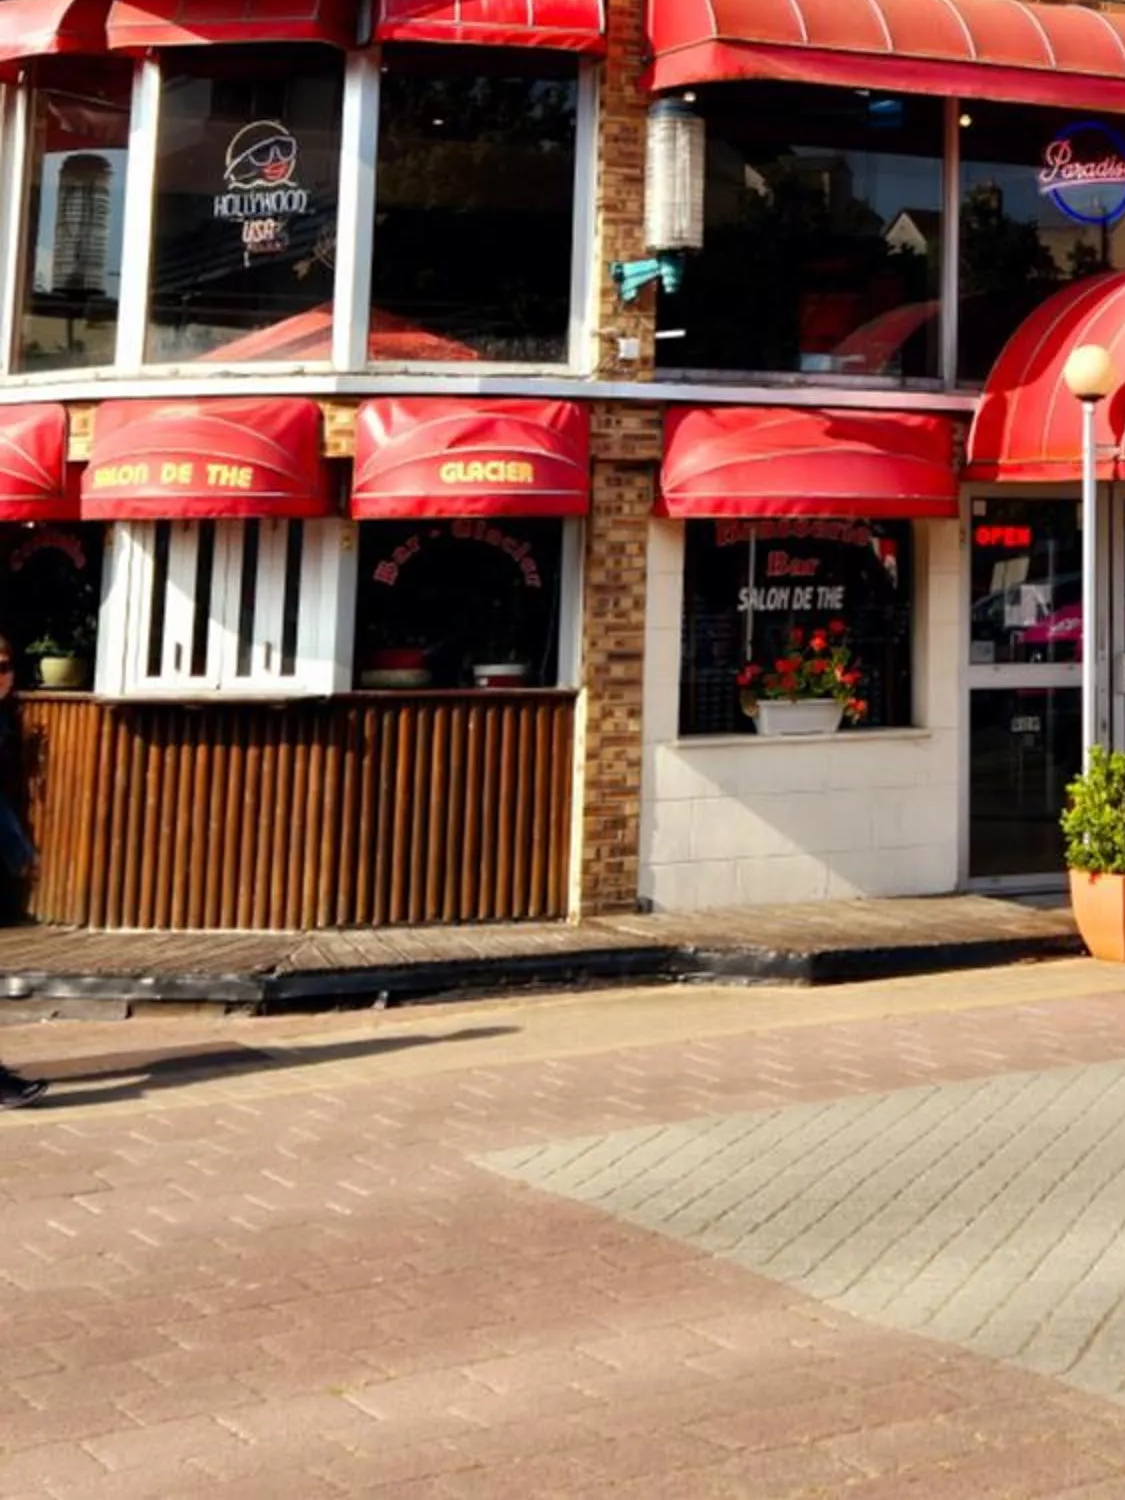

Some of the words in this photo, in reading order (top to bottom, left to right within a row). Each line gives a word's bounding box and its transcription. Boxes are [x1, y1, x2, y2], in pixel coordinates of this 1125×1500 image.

[213, 190, 308, 218] HOLLYWOOD
[242, 217, 276, 244] USA
[161, 462, 193, 485] DE
[207, 464, 254, 489] THE
[439, 459, 535, 484] GLACIER
[975, 525, 1031, 548] OPEN
[737, 587, 789, 612] SALON
[792, 587, 814, 610] DE
[817, 586, 845, 610] THE
